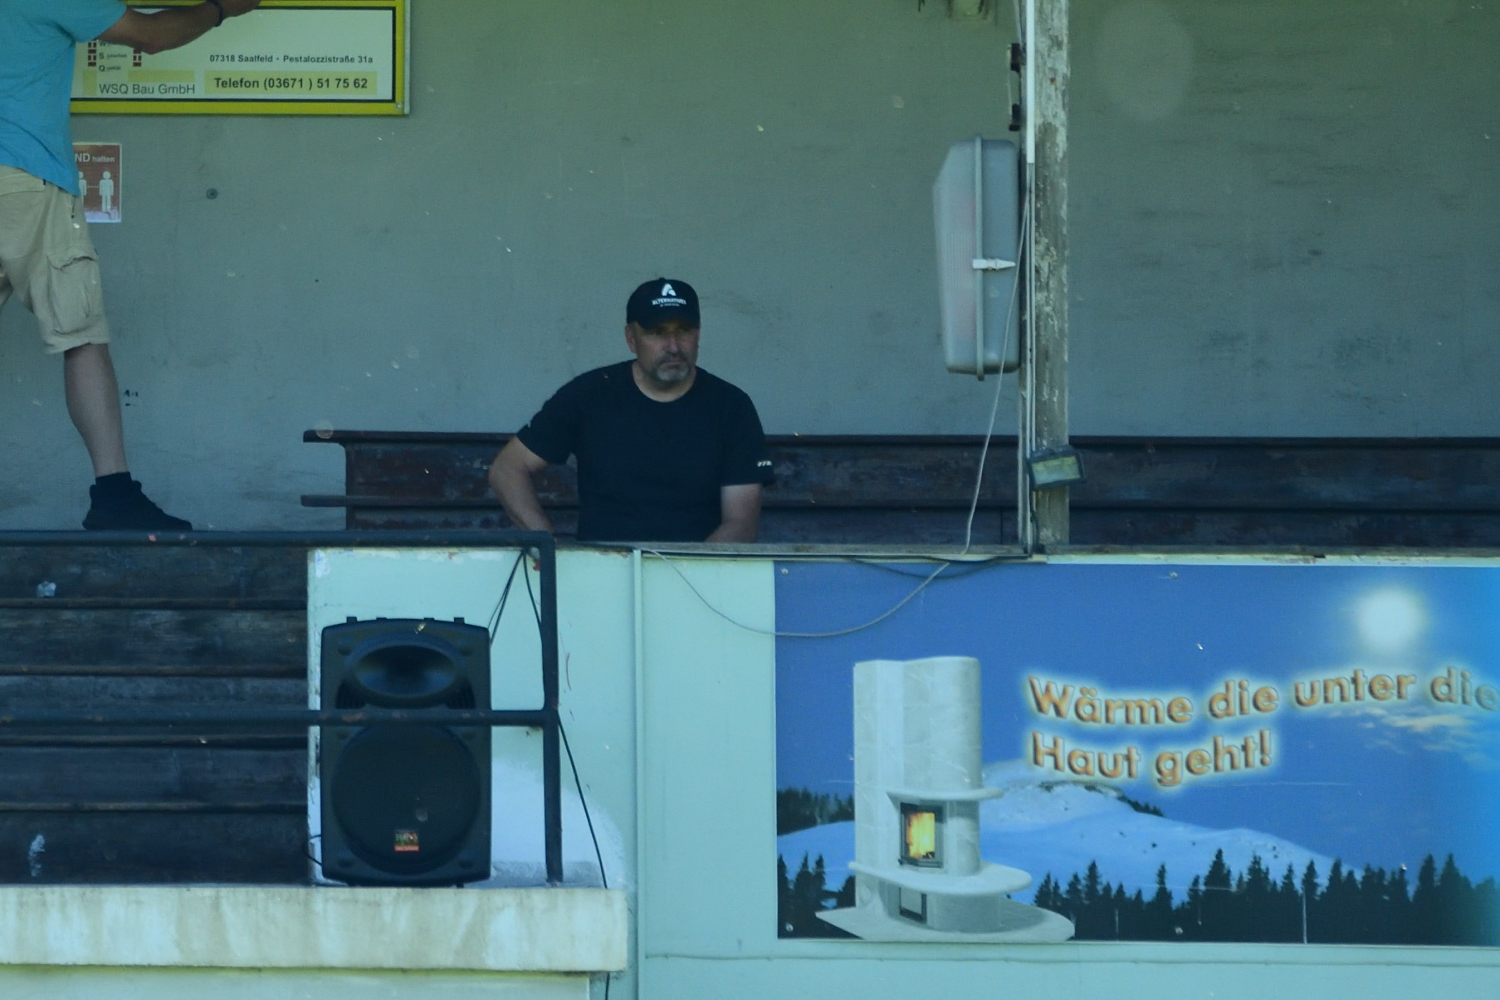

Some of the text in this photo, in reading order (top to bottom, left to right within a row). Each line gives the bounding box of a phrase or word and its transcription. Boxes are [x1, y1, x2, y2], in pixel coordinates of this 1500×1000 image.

[209, 54, 373, 64] 07318 Saalfeld Pestalozzistraße 31a
[99, 83, 195, 95] WSQ Bau GmbH
[214, 77, 260, 89] Telefon
[316, 78, 330, 89] 51
[335, 78, 350, 89] 75
[353, 78, 368, 89] 62
[1027, 665, 1500, 725] Wärme die unter die
[1031, 728, 1273, 787] Haut geht!
